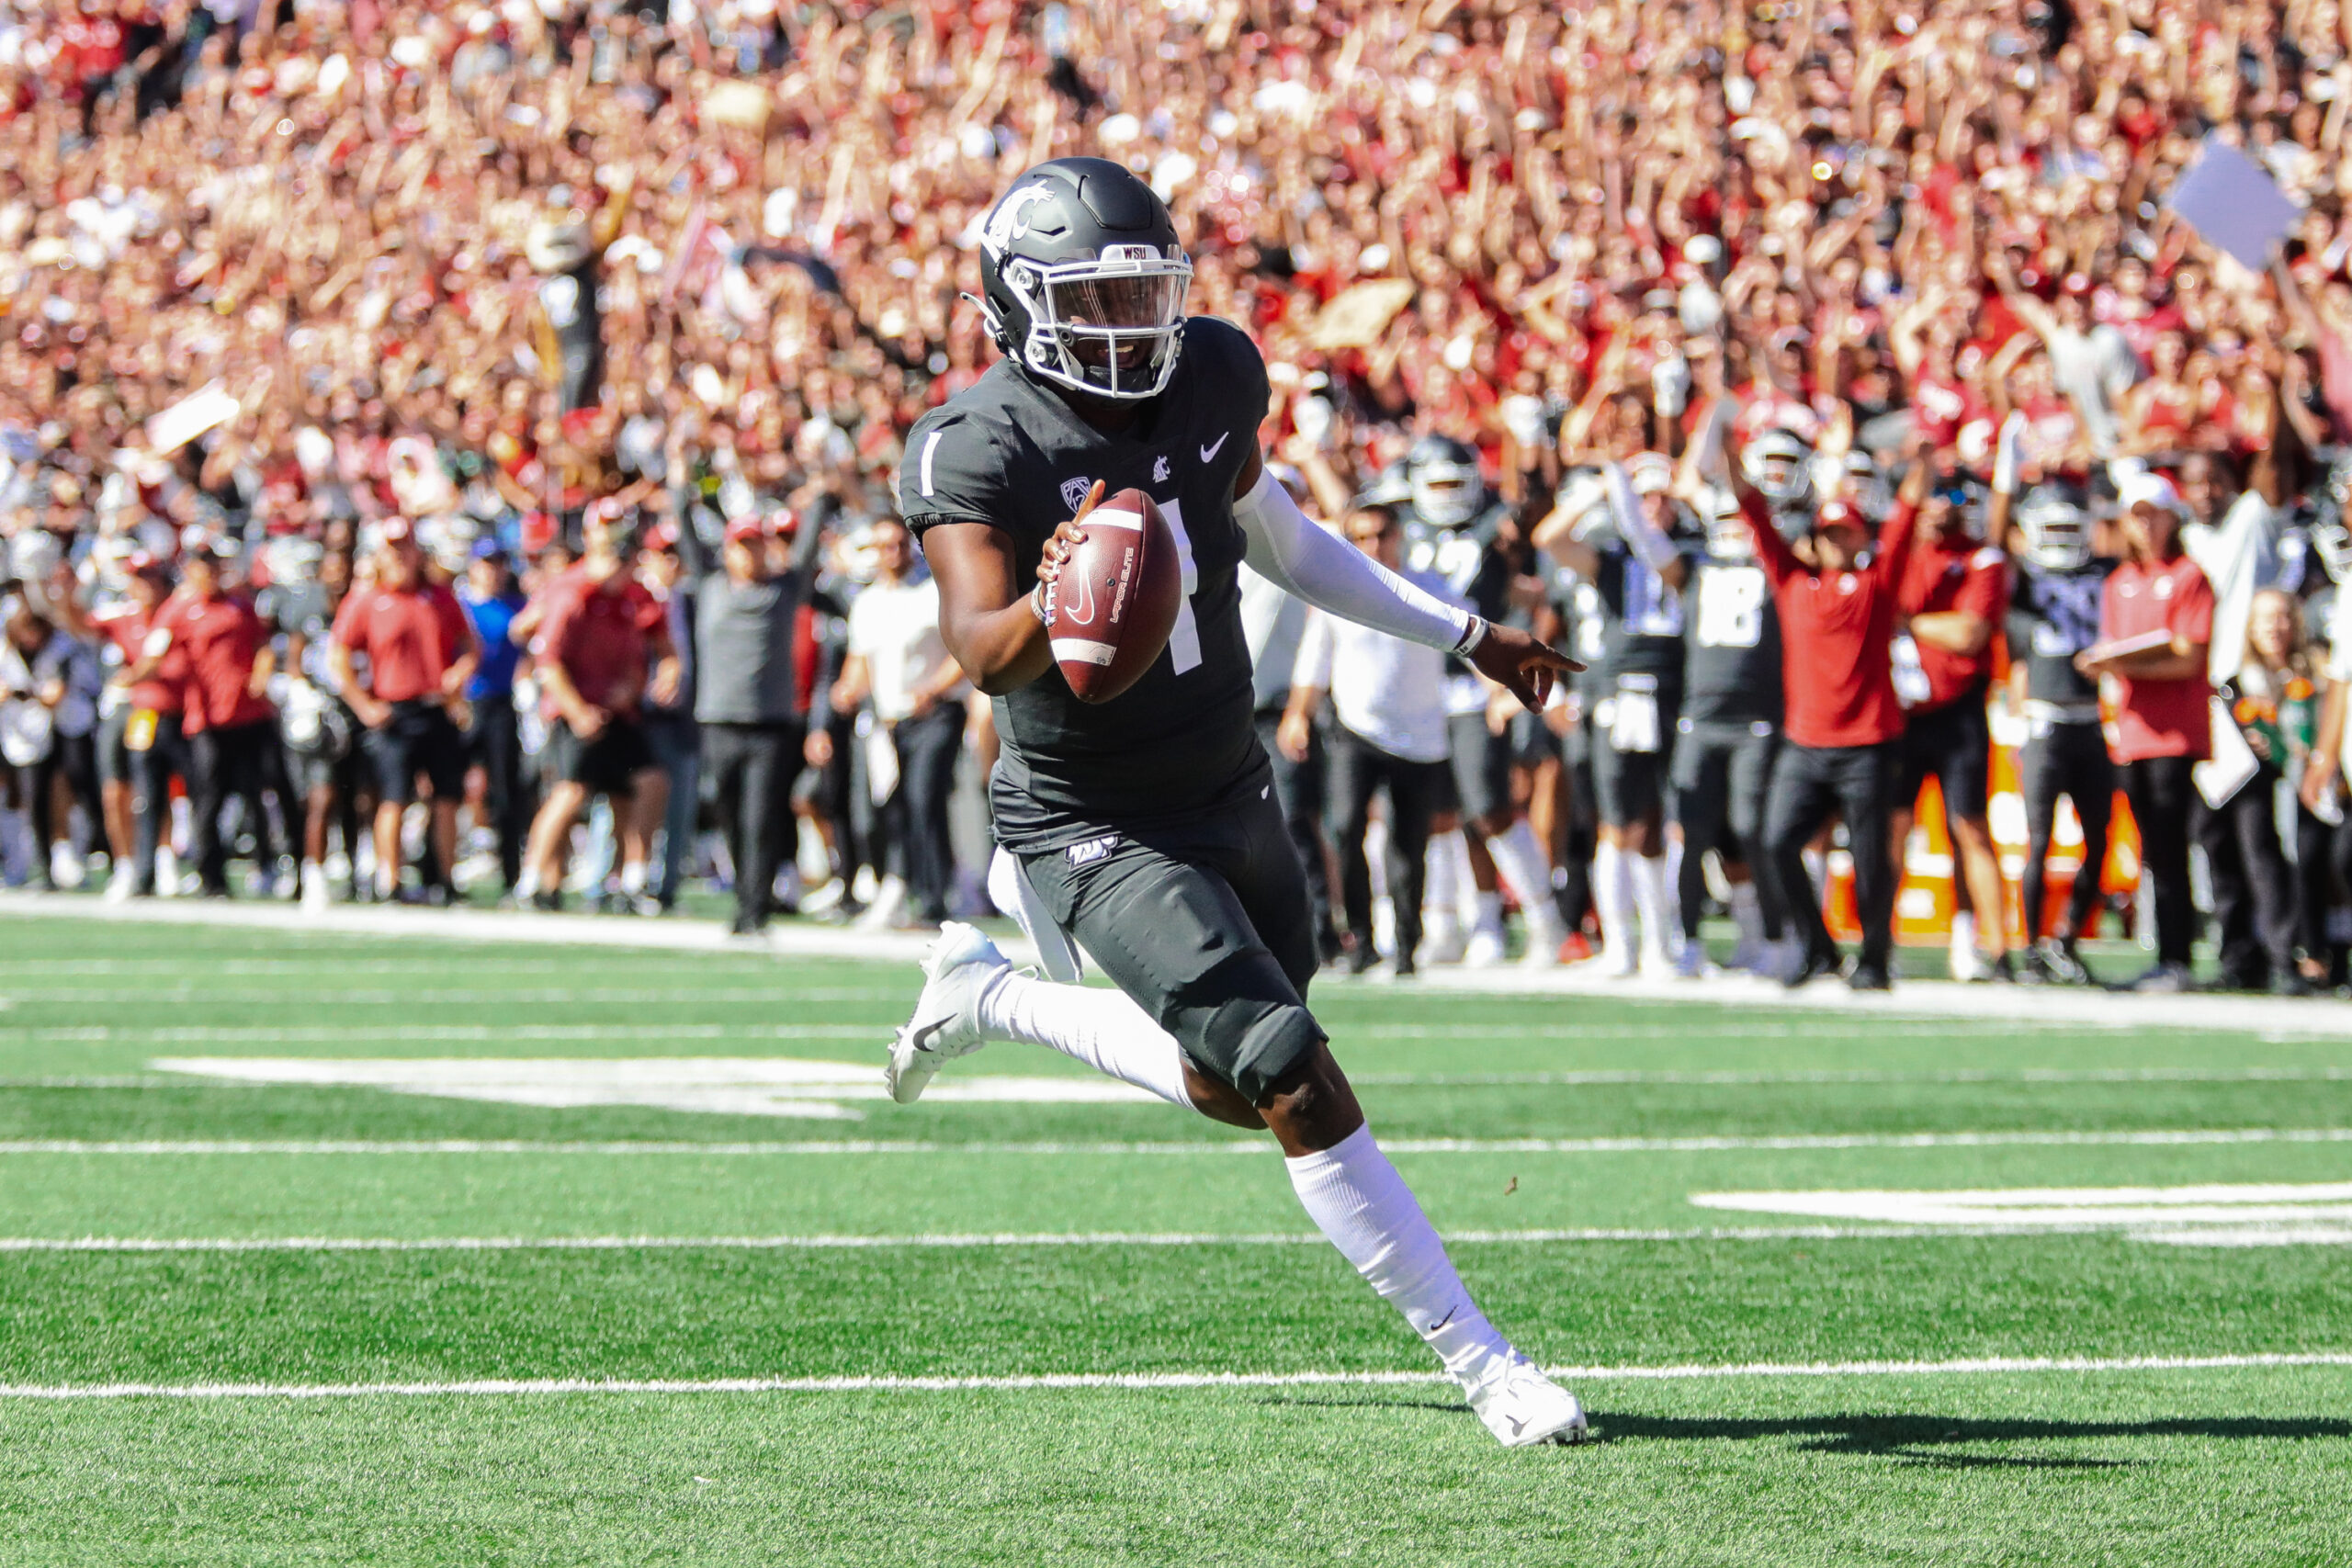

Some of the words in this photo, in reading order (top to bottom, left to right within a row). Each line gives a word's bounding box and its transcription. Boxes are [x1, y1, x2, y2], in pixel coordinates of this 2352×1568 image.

[1124, 247, 1147, 260] WSU
[921, 432, 943, 497] 1
[1063, 479, 1091, 504] PAC
[1120, 547, 1135, 582] ELITE
